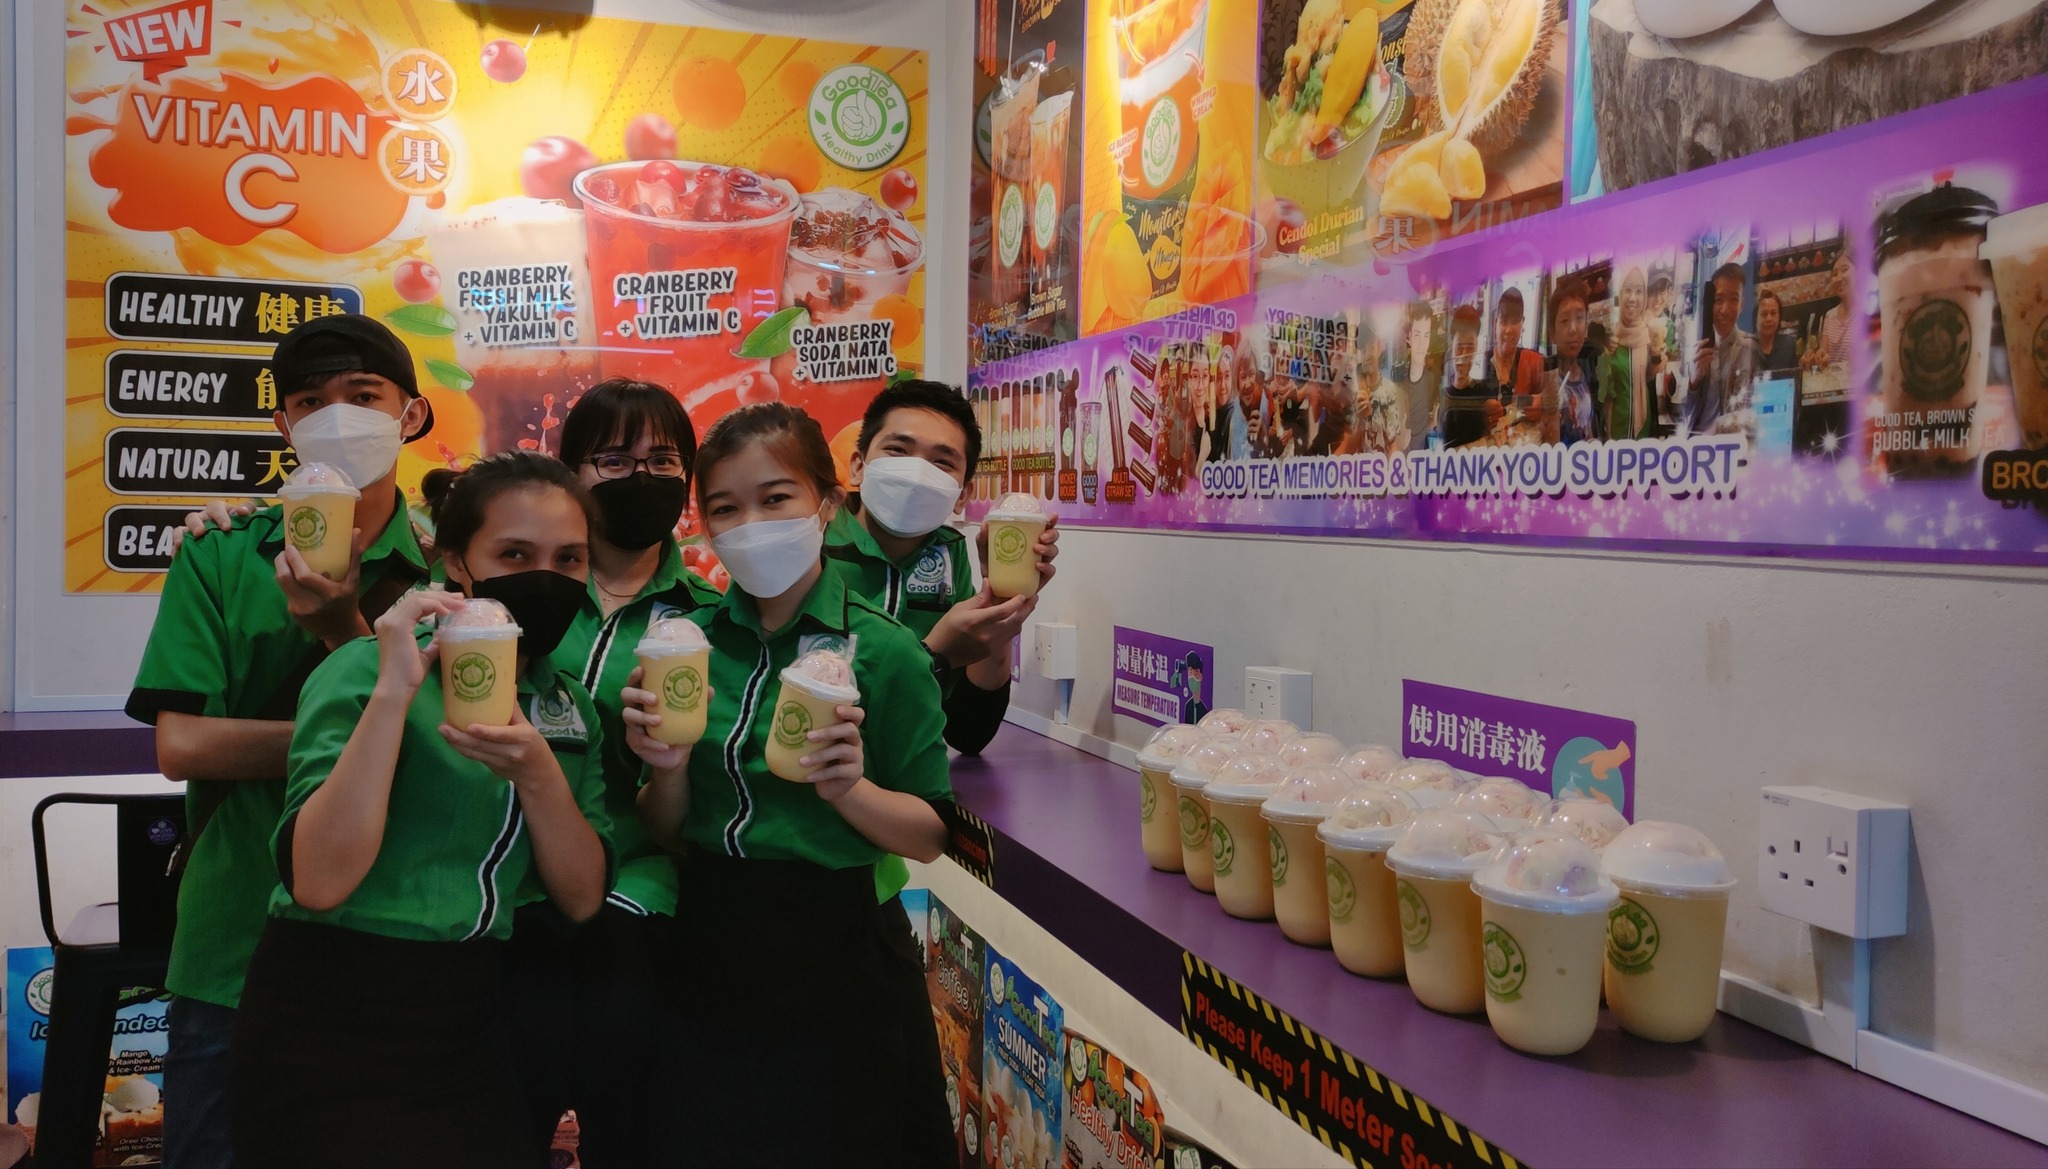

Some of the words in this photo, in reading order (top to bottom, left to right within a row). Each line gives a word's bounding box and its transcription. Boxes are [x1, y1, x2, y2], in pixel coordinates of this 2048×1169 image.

[108, 8, 203, 57] NEW
[821, 67, 898, 111] GoodTea
[133, 94, 367, 158] VITAMIN
[396, 60, 447, 184] 水果
[821, 131, 862, 165] Healthy
[866, 140, 895, 163] Drink
[223, 152, 299, 226] C
[1279, 216, 1318, 247] Cendol
[1320, 204, 1365, 233] Durian
[1298, 235, 1341, 266] Special
[458, 264, 571, 290] CRANBERRY
[616, 271, 735, 298] CRANBERRY
[118, 291, 243, 327] HEALTHY
[459, 287, 524, 308] FRESH
[526, 282, 573, 306] MILK
[649, 293, 709, 316] FRUIT
[480, 321, 560, 343] VITAMIN
[563, 319, 576, 339] C
[483, 303, 554, 325] YAKULT
[619, 321, 632, 337] +
[637, 310, 724, 335] VITAMIN
[726, 308, 741, 330] C
[792, 321, 892, 346] CRANBERRY
[799, 344, 842, 363] SODA
[846, 340, 888, 359] NATA
[808, 359, 880, 382] VITAMIN
[882, 356, 896, 376] C
[118, 369, 227, 404] ENERGY
[1875, 412, 1901, 428] GOOD
[1927, 409, 1966, 425] BROWN
[1873, 429, 1929, 451] BUBBLE
[1934, 428, 1971, 449] MILK
[118, 447, 245, 481] NATURAL
[1082, 475, 1097, 486] GOOD
[1202, 464, 1246, 491] GOOD
[1248, 463, 1280, 490] TEA
[1284, 459, 1384, 491] MEMORIES
[1388, 457, 1406, 489] &
[1410, 451, 1501, 491] THANK
[1502, 447, 1564, 488] YOU
[1570, 443, 1741, 487] SUPPORT
[1117, 643, 1169, 683] 测量体温
[1117, 684, 1140, 706] MEASURE
[1141, 691, 1178, 719] TEMPERATURE
[1408, 703, 1547, 775] 使用消毒液
[936, 955, 969, 1011] Coffee
[116, 1057, 151, 1067] Rainbow
[121, 1051, 148, 1060] Mango
[998, 1016, 1046, 1086] SUMMER
[133, 1064, 160, 1073] Cream
[1196, 991, 1246, 1051] Please
[1250, 1028, 1295, 1091] Keep
[1300, 1057, 1311, 1099] 1
[1320, 1069, 1395, 1158] Meter
[1071, 1085, 1115, 1157] Healthy
